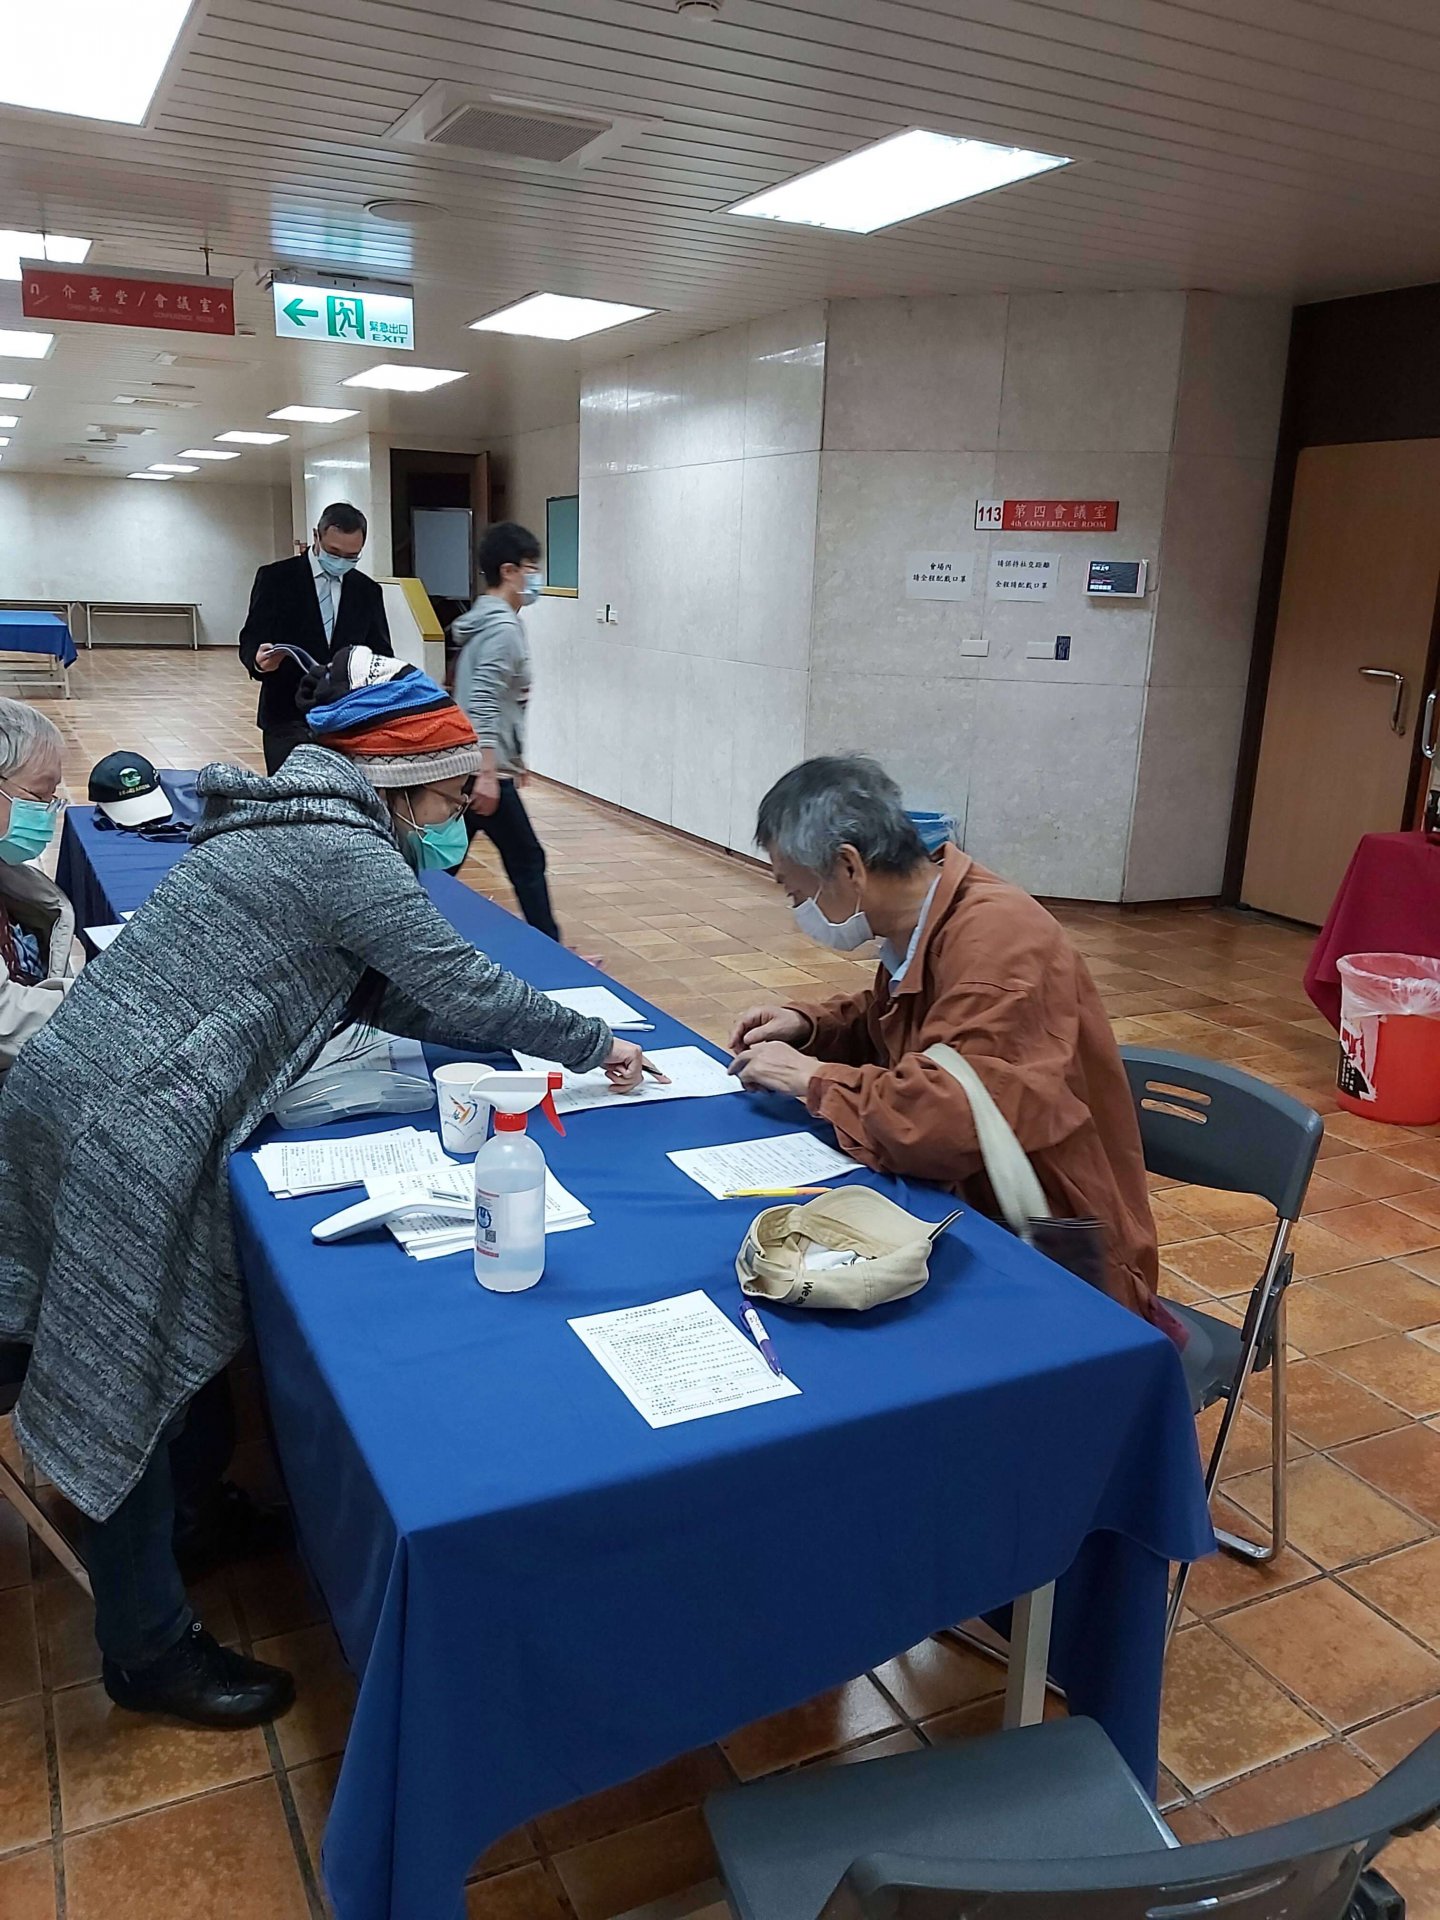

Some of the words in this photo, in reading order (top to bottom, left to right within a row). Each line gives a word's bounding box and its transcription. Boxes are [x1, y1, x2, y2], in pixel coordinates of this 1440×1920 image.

[369, 321, 408, 334] 緊急出口
[372, 333, 407, 343] EXIT
[978, 506, 1002, 521] 113
[1015, 504, 1107, 519] 第四會議室
[1024, 520, 1078, 528] CONFERENCE
